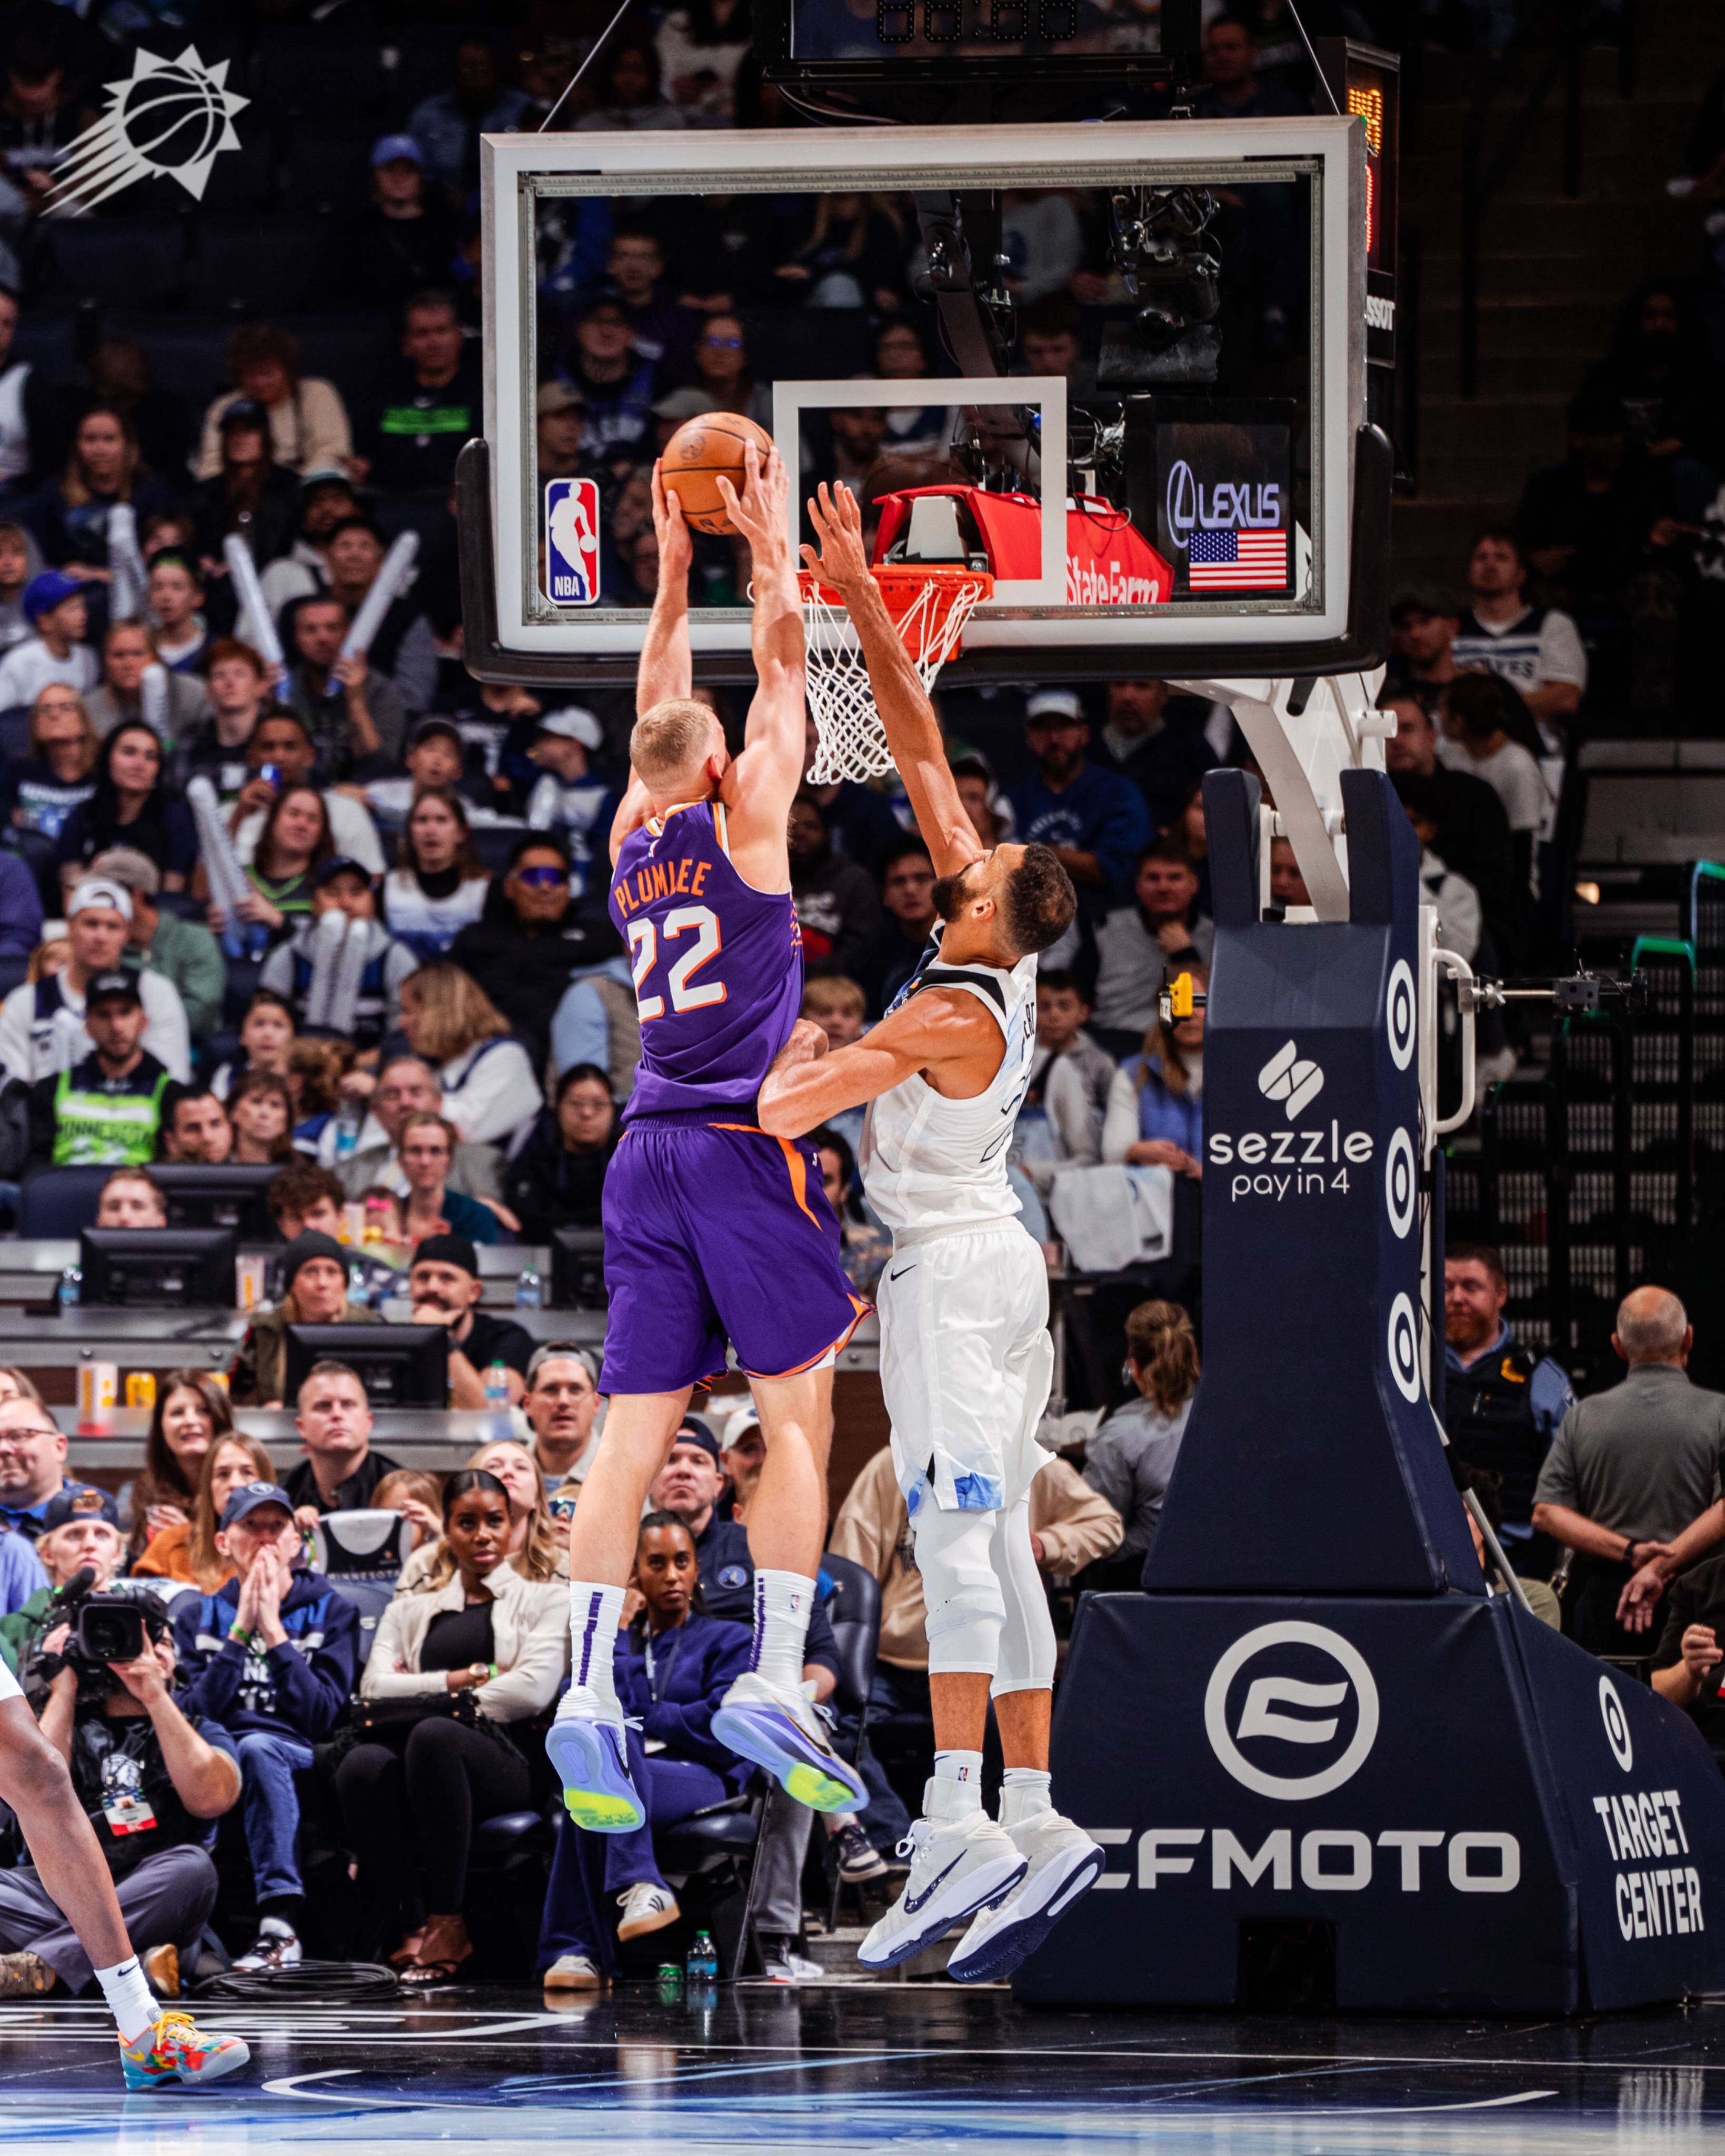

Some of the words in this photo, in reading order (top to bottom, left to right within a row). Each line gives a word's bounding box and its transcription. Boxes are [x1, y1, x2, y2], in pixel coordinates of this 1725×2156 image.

[1367, 295, 1395, 331] SSOT
[1198, 483, 1280, 528] LEXUS
[554, 576, 580, 597] NBA
[627, 905, 727, 1024] 22
[1209, 1119, 1373, 1164] sezzle
[1232, 1174, 1291, 1203] pay
[1298, 1167, 1324, 1194] in
[1330, 1167, 1350, 1195] 4
[1593, 1790, 1689, 1861] TARGET
[1616, 1867, 1704, 1941] CENTER
